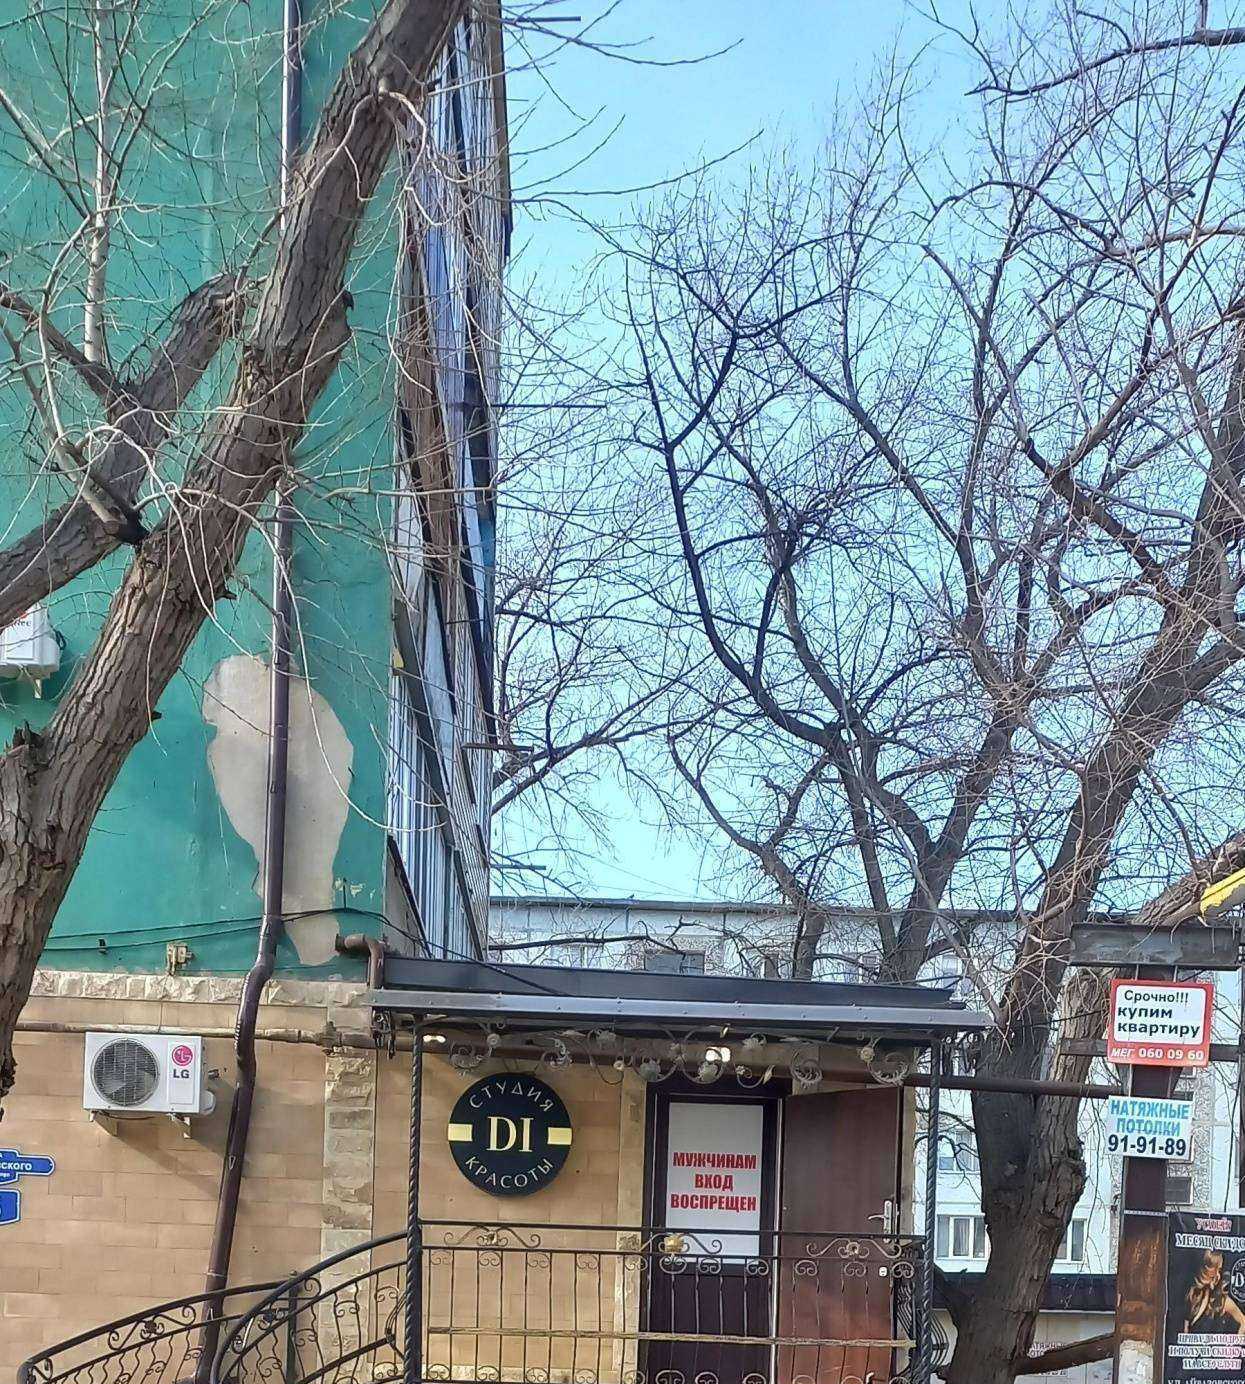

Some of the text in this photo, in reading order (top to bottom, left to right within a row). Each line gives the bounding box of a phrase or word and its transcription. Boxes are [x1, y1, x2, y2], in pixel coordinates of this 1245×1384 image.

[1124, 990, 1189, 1003] Срочно!!!
[1117, 1006, 1173, 1020] купим
[1117, 1022, 1200, 1038] квартиру
[1138, 1048, 1163, 1059] 060
[1167, 1049, 1184, 1060] 09
[1187, 1050, 1204, 1060] 60
[173, 1069, 190, 1079] LG
[469, 1080, 554, 1112] СТУДИЯ
[1110, 1099, 1190, 1119] НАТЯЖНЫЕ
[486, 1116, 534, 1152] DI
[1116, 1117, 1181, 1137] ПОТОЛКИ
[1108, 1134, 1187, 1156] 91-91-89
[0, 1162, 32, 1171] ского
[672, 1152, 757, 1169] МУЖЧИНАМ
[465, 1156, 554, 1188] КРАСОТЫ
[694, 1174, 733, 1191] ВХОД
[670, 1194, 756, 1212] ВОСПРЕЩЕН
